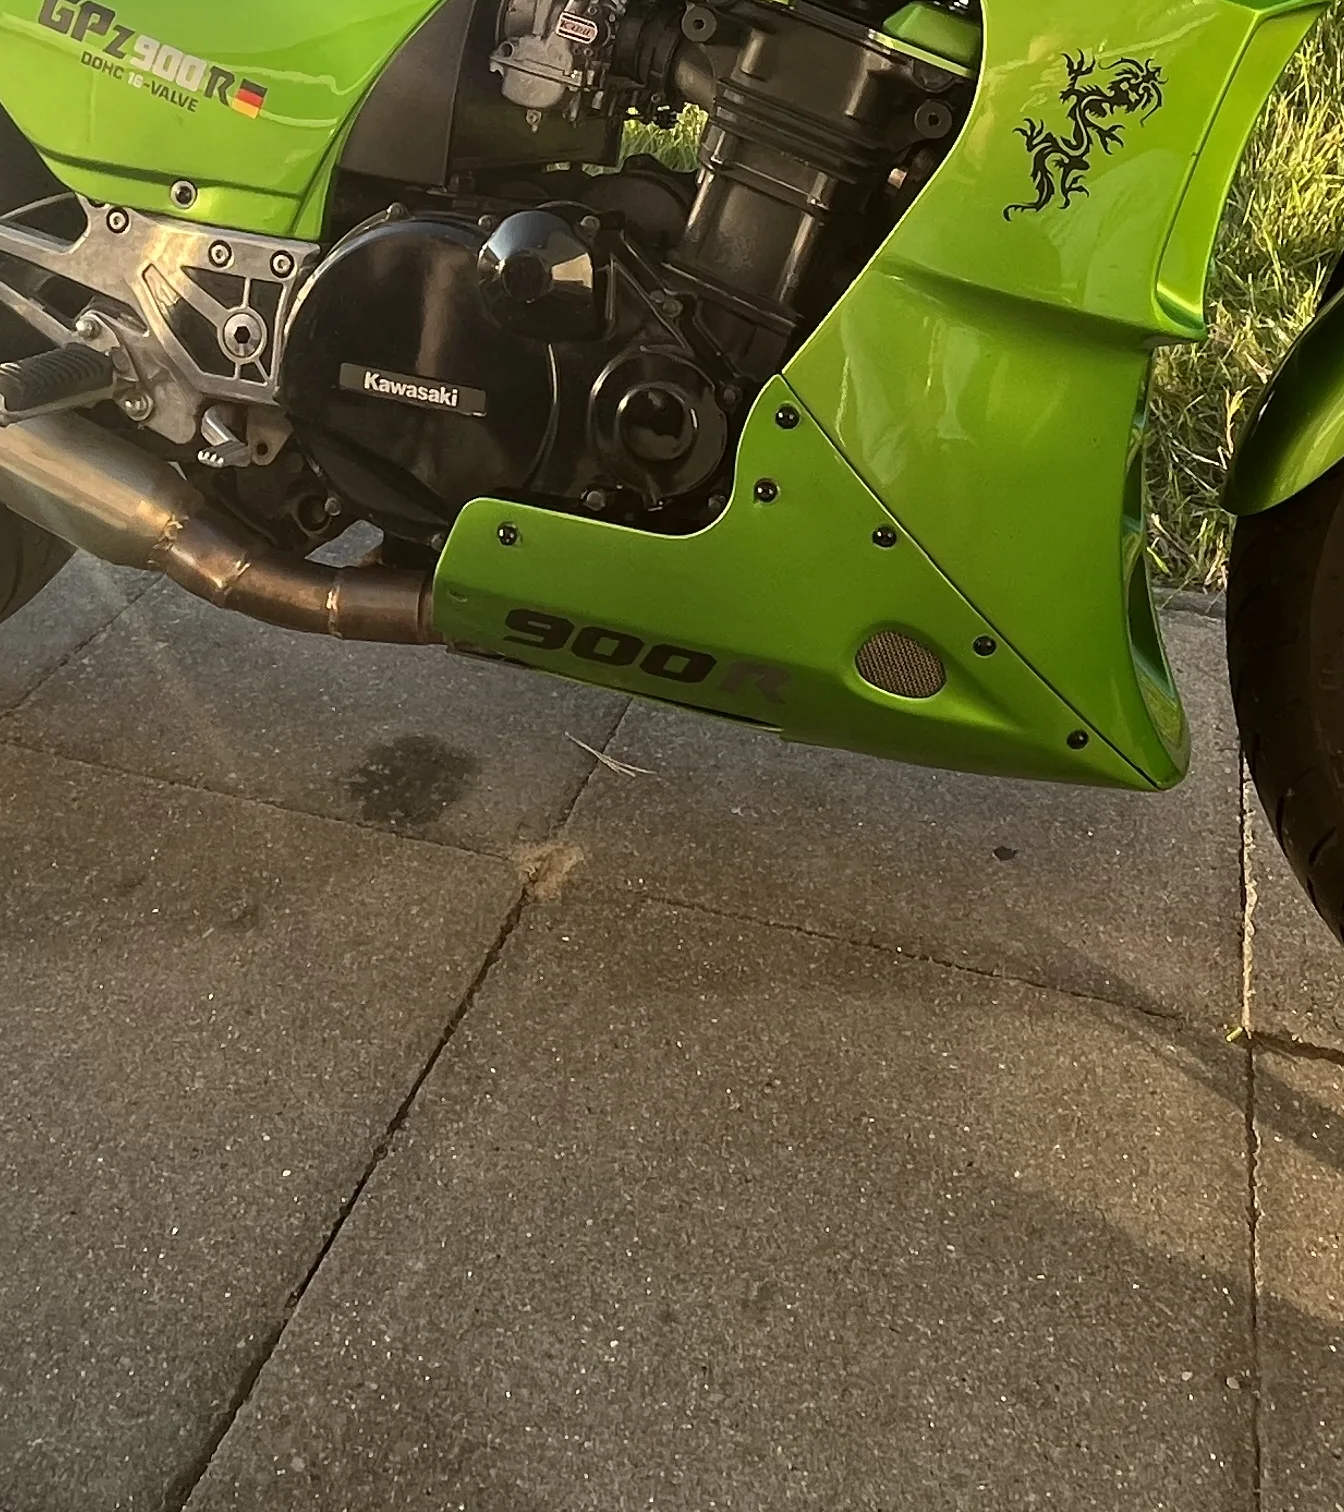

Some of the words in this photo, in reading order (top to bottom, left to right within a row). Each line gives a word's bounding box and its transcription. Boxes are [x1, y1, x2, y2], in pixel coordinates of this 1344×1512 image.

[80, 50, 125, 80] DOHC
[127, 71, 199, 113] 16-VALVE
[363, 371, 458, 407] Kawasaki
[504, 608, 792, 705] 900R
